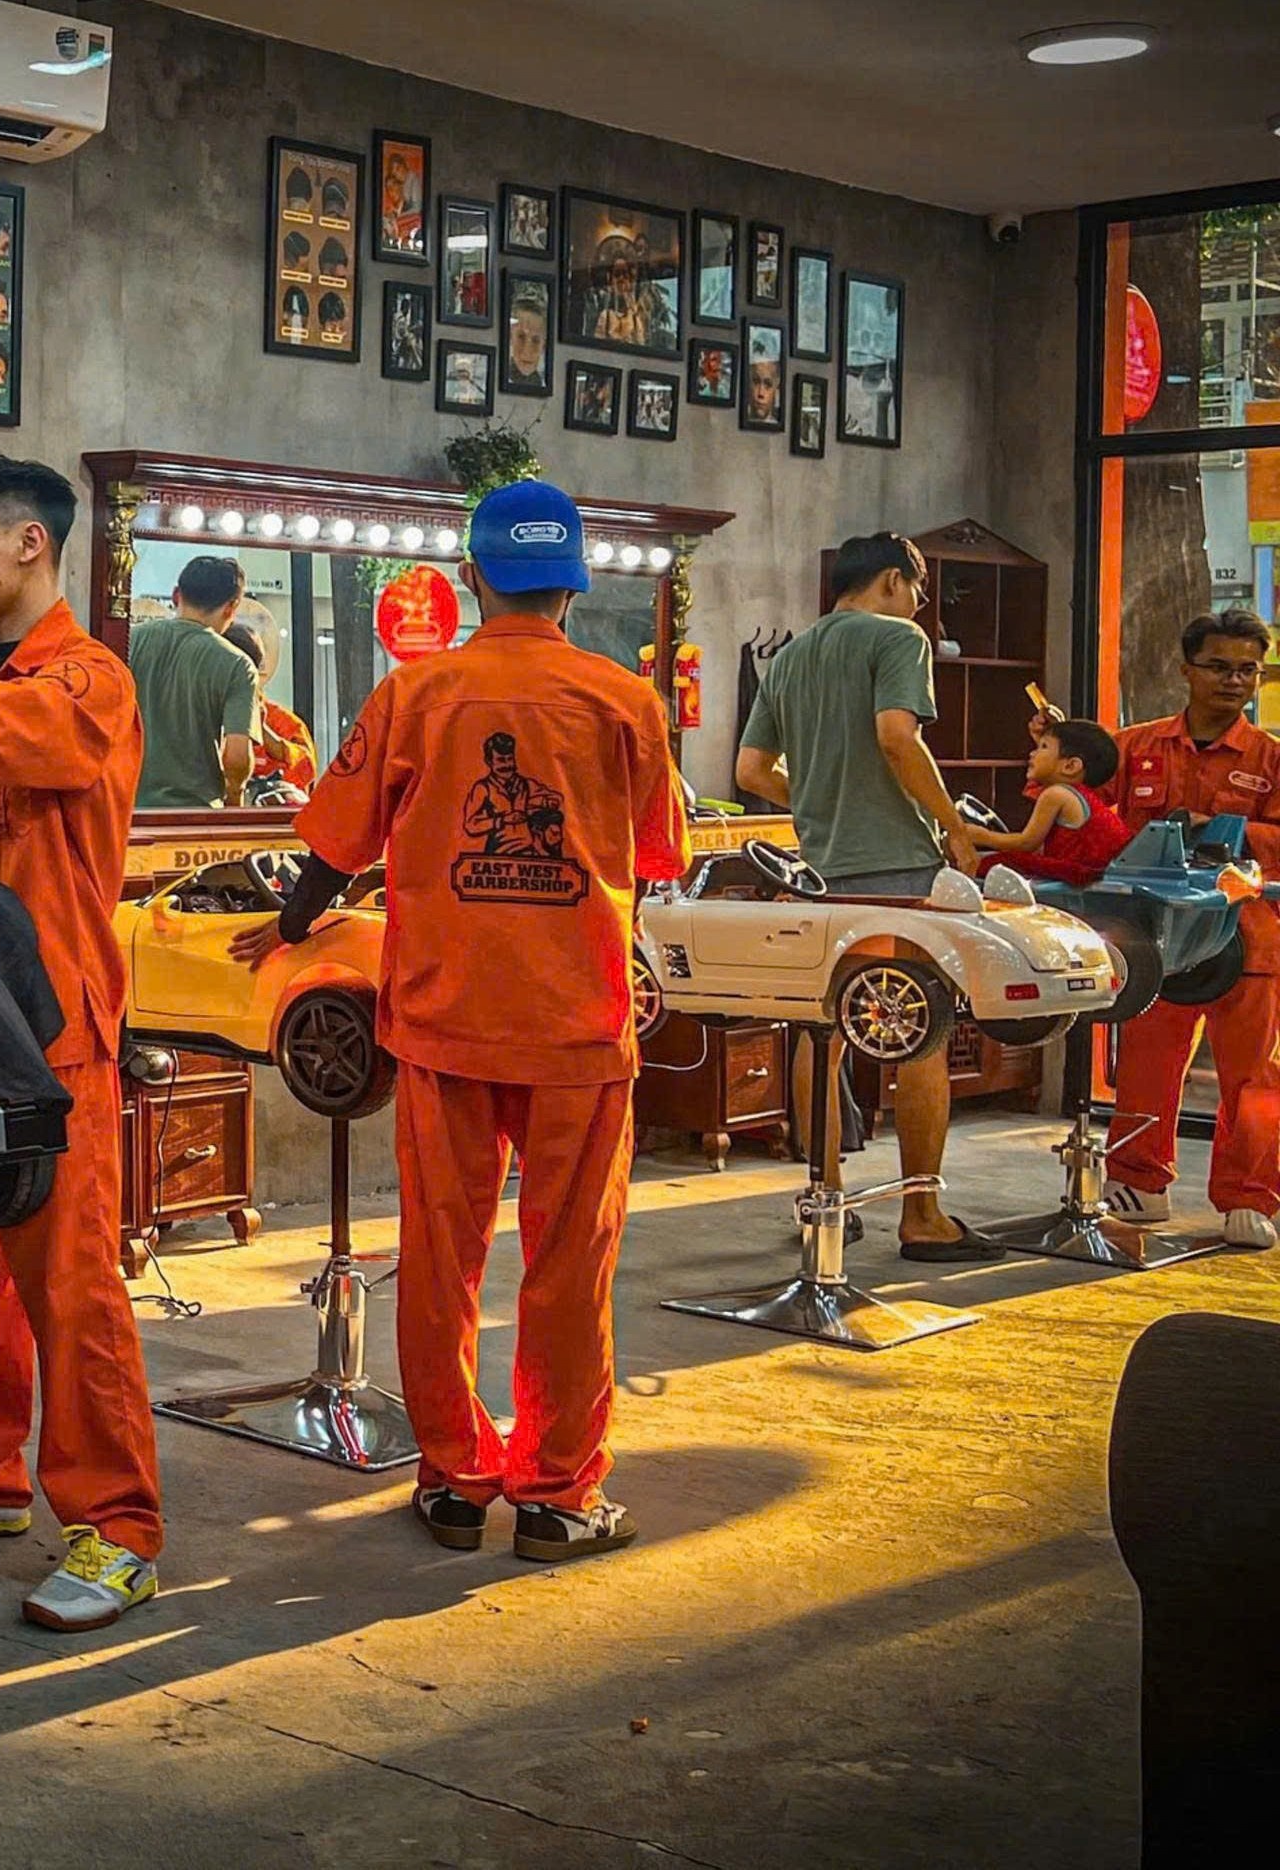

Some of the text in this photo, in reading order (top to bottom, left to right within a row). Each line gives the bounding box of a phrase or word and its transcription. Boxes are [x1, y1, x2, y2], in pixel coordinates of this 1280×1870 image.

[471, 862, 563, 878] EAST WEST
[463, 875, 573, 894] BARBERSHOP
